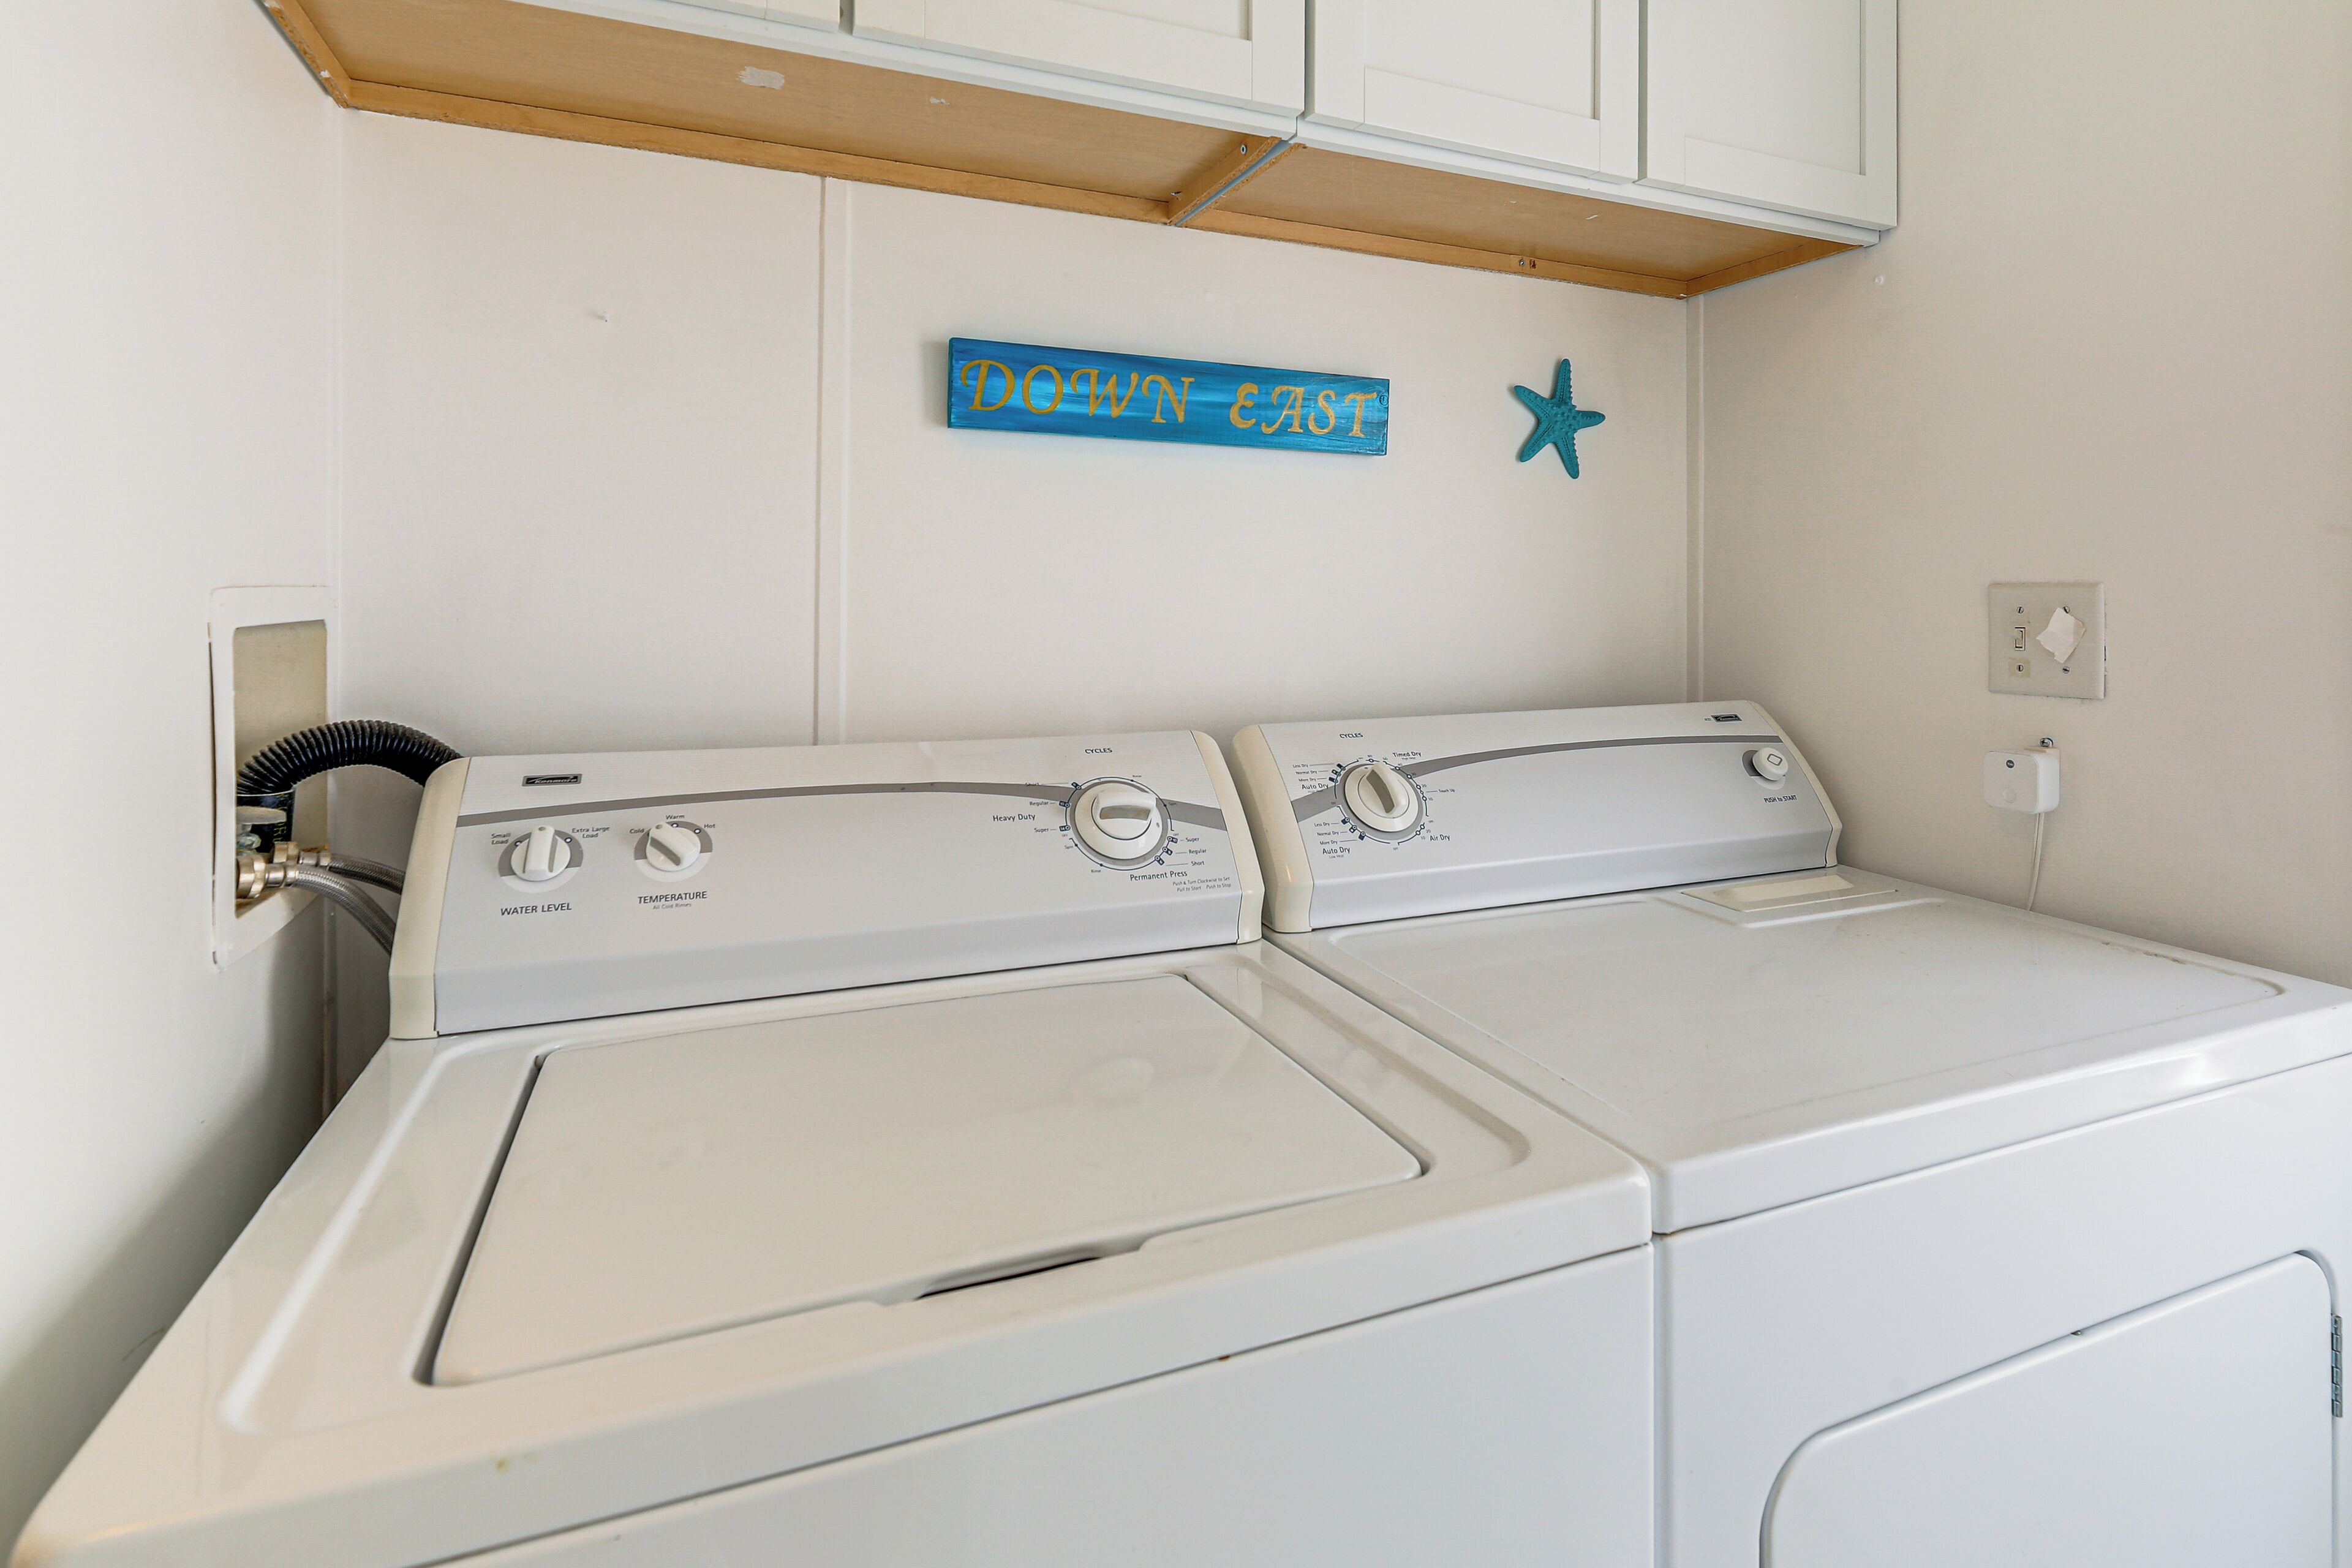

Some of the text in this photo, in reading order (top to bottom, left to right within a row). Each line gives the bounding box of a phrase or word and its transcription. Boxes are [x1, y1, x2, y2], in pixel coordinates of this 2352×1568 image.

[960, 359, 1378, 437] DOWN EAST
[1130, 872, 1167, 881] Permanent
[638, 891, 707, 904] TEMPERATURE
[500, 902, 572, 916] WATER LEVEL
